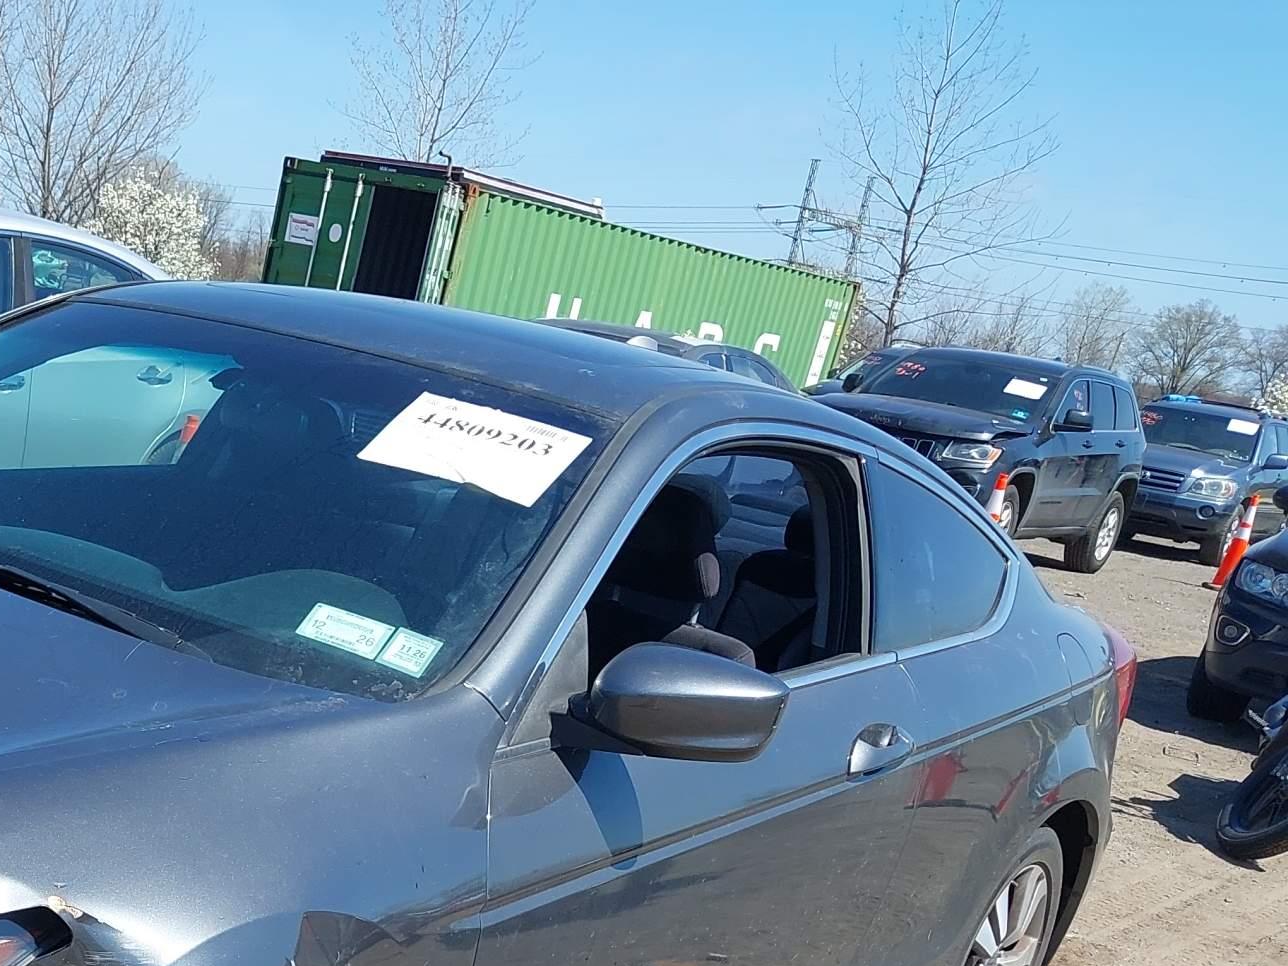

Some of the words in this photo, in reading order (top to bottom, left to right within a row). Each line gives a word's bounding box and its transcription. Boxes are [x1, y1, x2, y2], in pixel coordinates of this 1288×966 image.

[417, 413, 553, 456] 44809203
[312, 619, 327, 631] 12
[356, 634, 377, 648] 26
